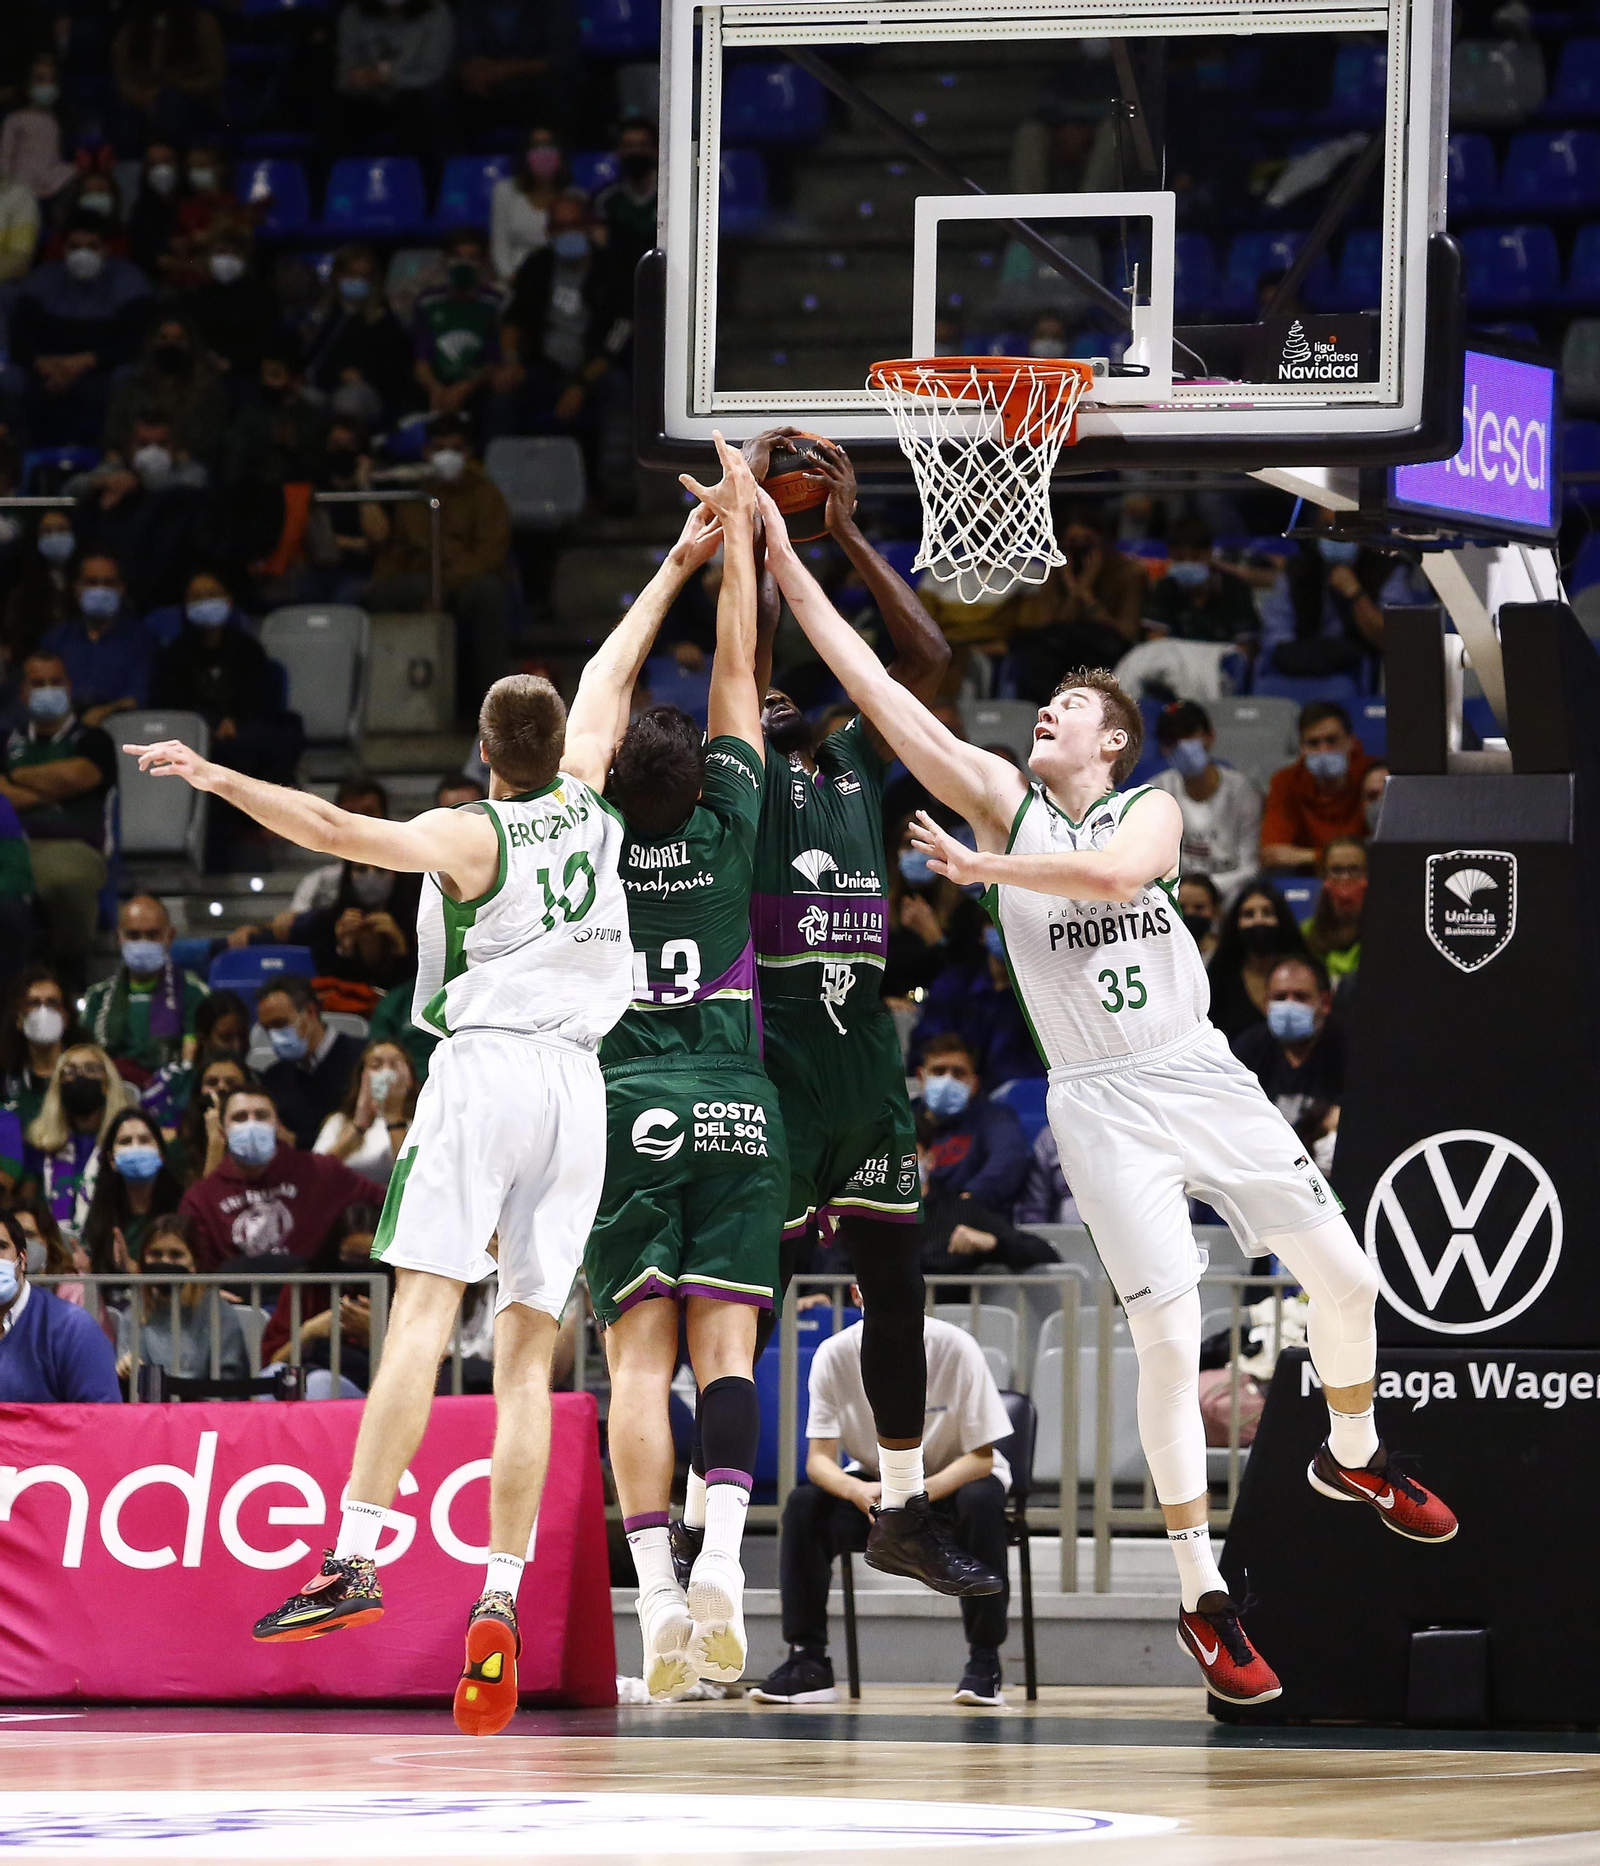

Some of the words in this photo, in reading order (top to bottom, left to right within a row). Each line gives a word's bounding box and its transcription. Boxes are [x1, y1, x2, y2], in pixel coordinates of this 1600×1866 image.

[1314, 352, 1359, 362] endesa
[1278, 362, 1358, 380] Navidad
[1445, 384, 1545, 491] desa
[536, 850, 596, 932] 10
[835, 870, 881, 892] Unicaja
[1444, 908, 1496, 925] Unicaja
[594, 927, 622, 943] FUTUR
[1049, 907, 1171, 950] PROBITAS
[1444, 926, 1497, 936] Baloncesto
[633, 938, 702, 1004] 13
[1098, 965, 1148, 1013] 35
[692, 1101, 767, 1125] COSTA
[693, 1122, 730, 1137] DEL
[733, 1123, 767, 1141] SOL
[694, 1137, 768, 1158] MÁLAGA
[850, 1170, 886, 1187] aga
[1301, 1361, 1457, 1412] Maga
[1468, 1362, 1600, 1410] Wage
